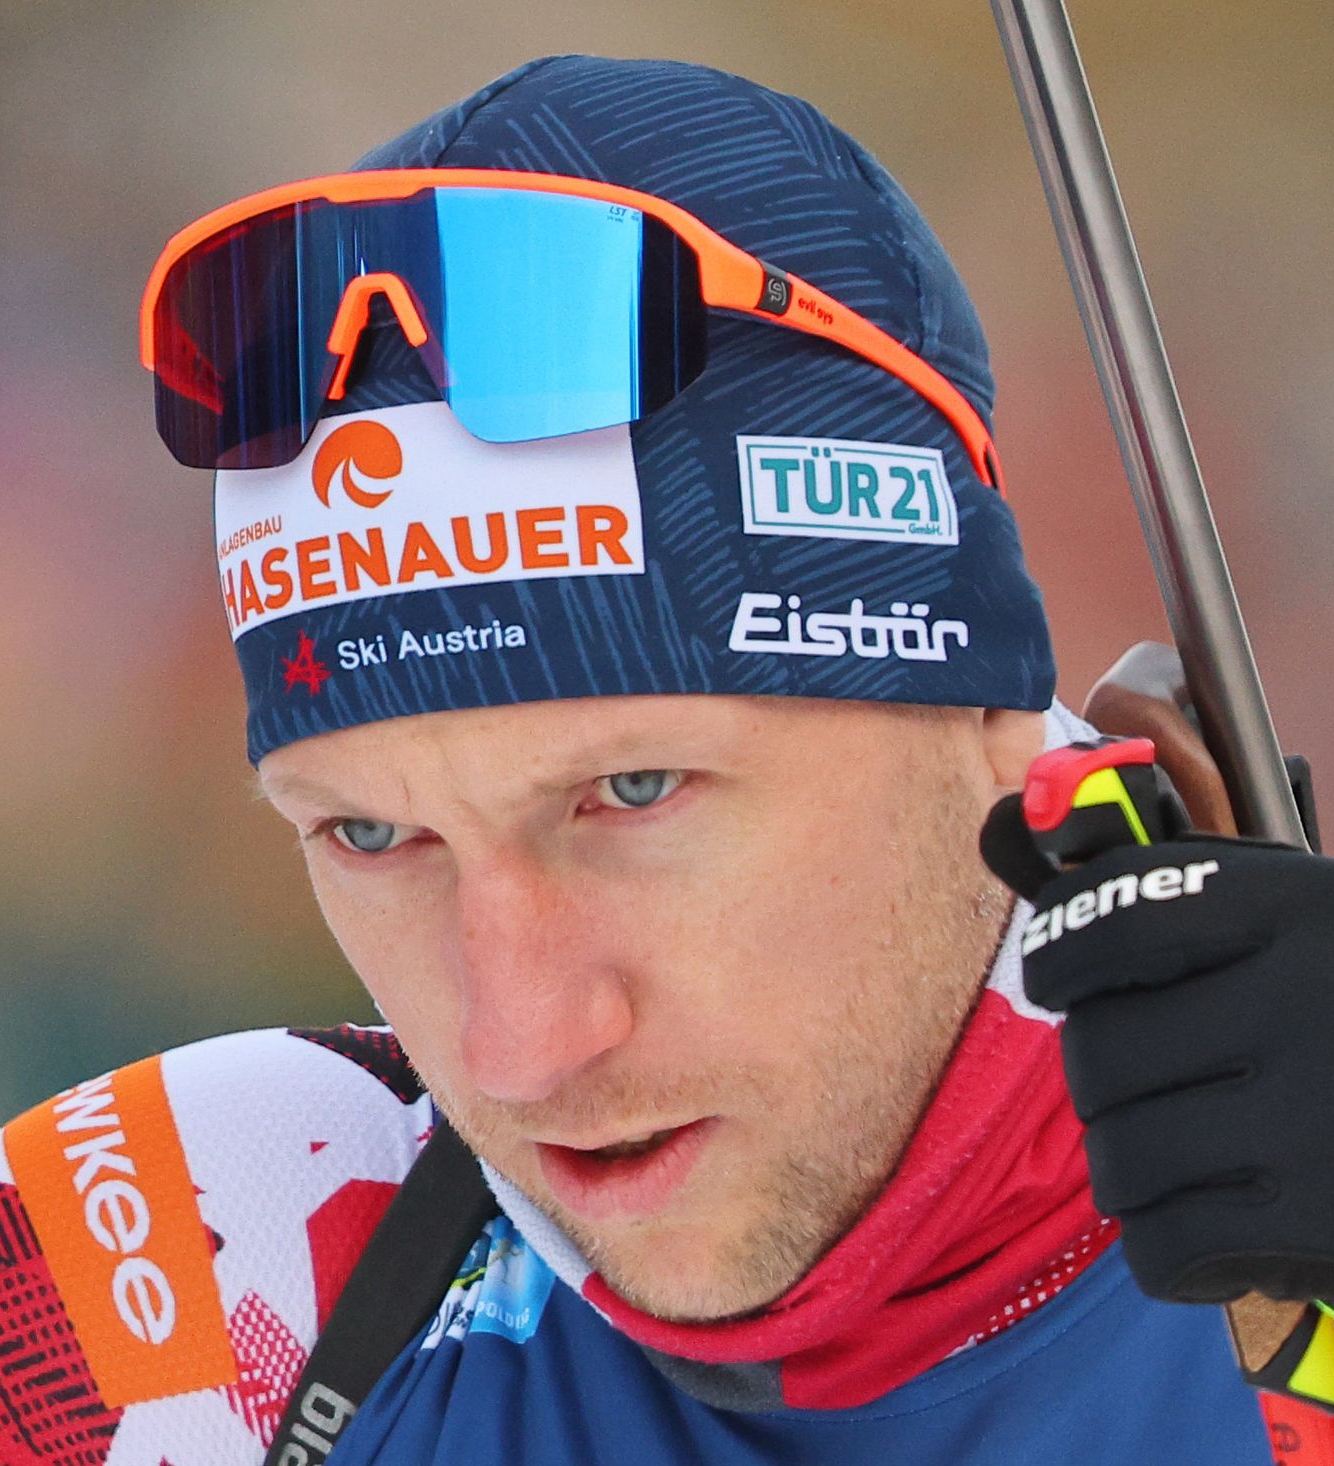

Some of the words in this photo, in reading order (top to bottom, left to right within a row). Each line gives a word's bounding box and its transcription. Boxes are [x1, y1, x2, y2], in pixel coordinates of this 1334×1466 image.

[760, 447, 881, 519] TÜR
[889, 466, 940, 522] 21
[221, 505, 634, 632] HASENAUER
[338, 638, 388, 670] Ski
[398, 620, 527, 661] Austria
[728, 592, 969, 662] Eisbär
